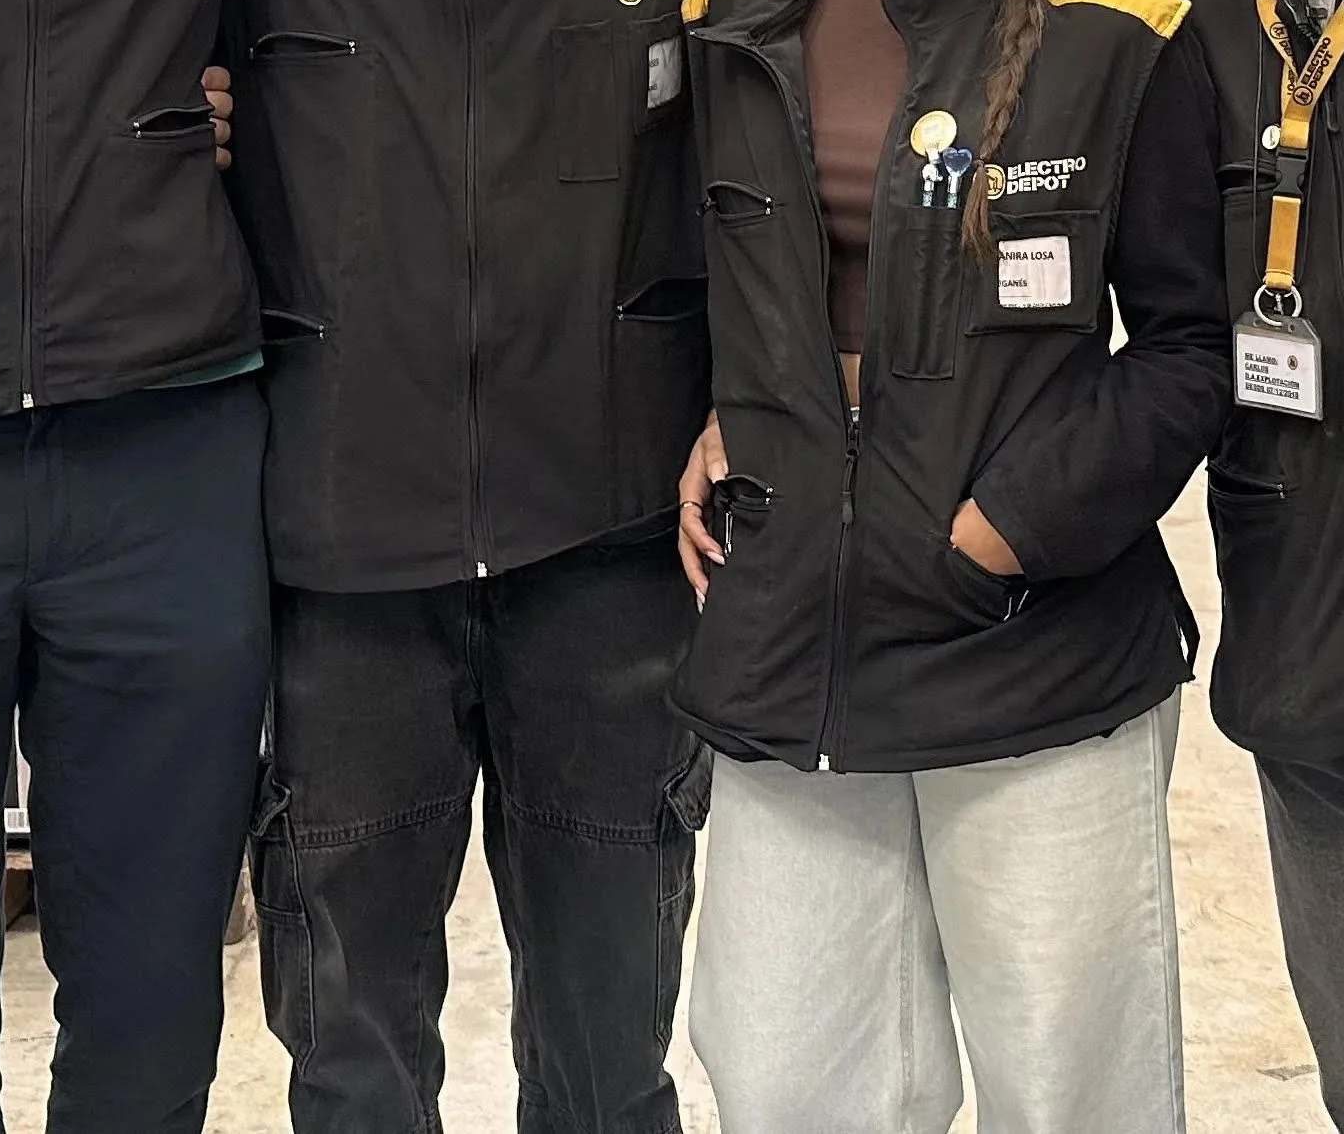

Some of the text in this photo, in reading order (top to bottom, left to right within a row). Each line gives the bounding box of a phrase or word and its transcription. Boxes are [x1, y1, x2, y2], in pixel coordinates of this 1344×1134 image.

[1301, 36, 1333, 87] ELECTRO
[1310, 49, 1335, 91] DEPOT
[1007, 156, 1087, 181] ELECTRO
[1006, 174, 1071, 195] DEPOT
[998, 251, 1055, 261] ANIRA LOSA
[998, 277, 1028, 289] GANÉS
